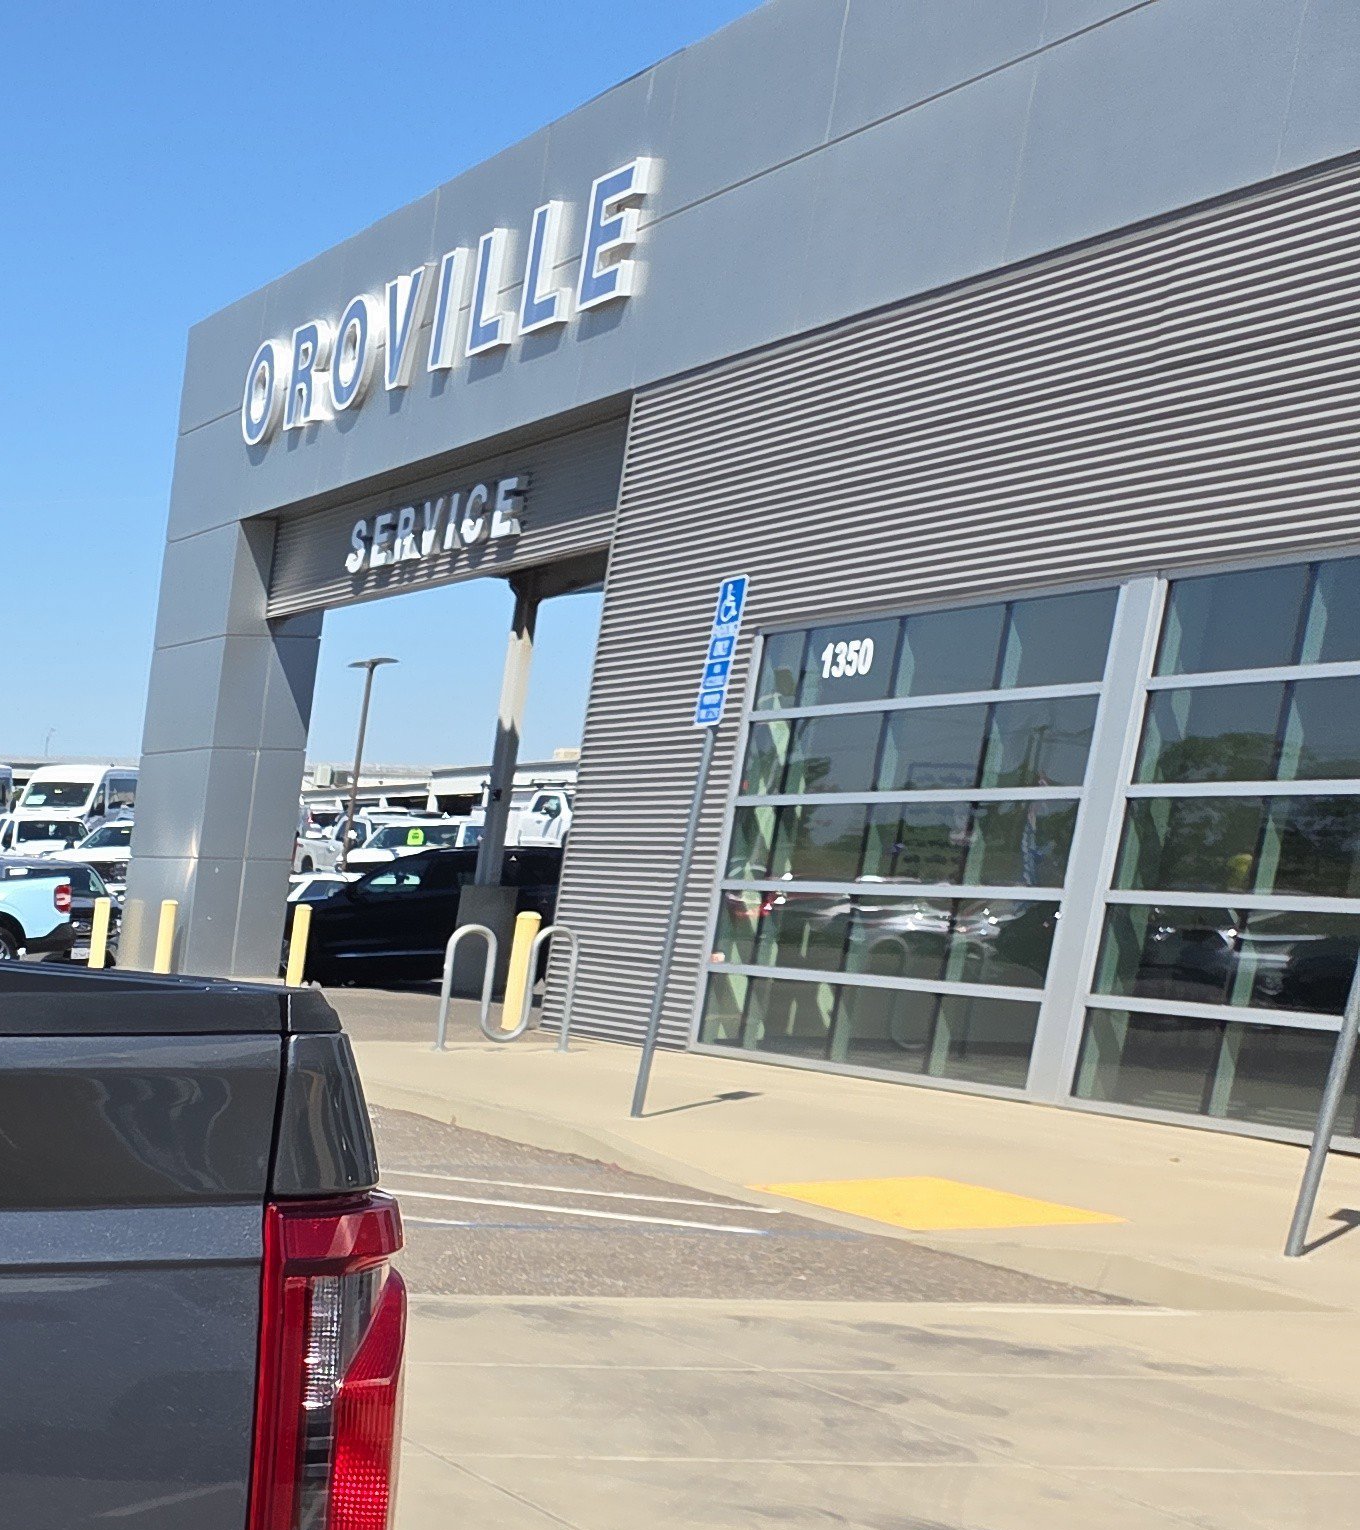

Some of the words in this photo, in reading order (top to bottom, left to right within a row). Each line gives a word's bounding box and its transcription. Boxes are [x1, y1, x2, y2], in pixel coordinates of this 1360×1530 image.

[242, 156, 654, 446] OROVILLE
[345, 474, 528, 574] SERVICE
[821, 638, 874, 679] 1350
